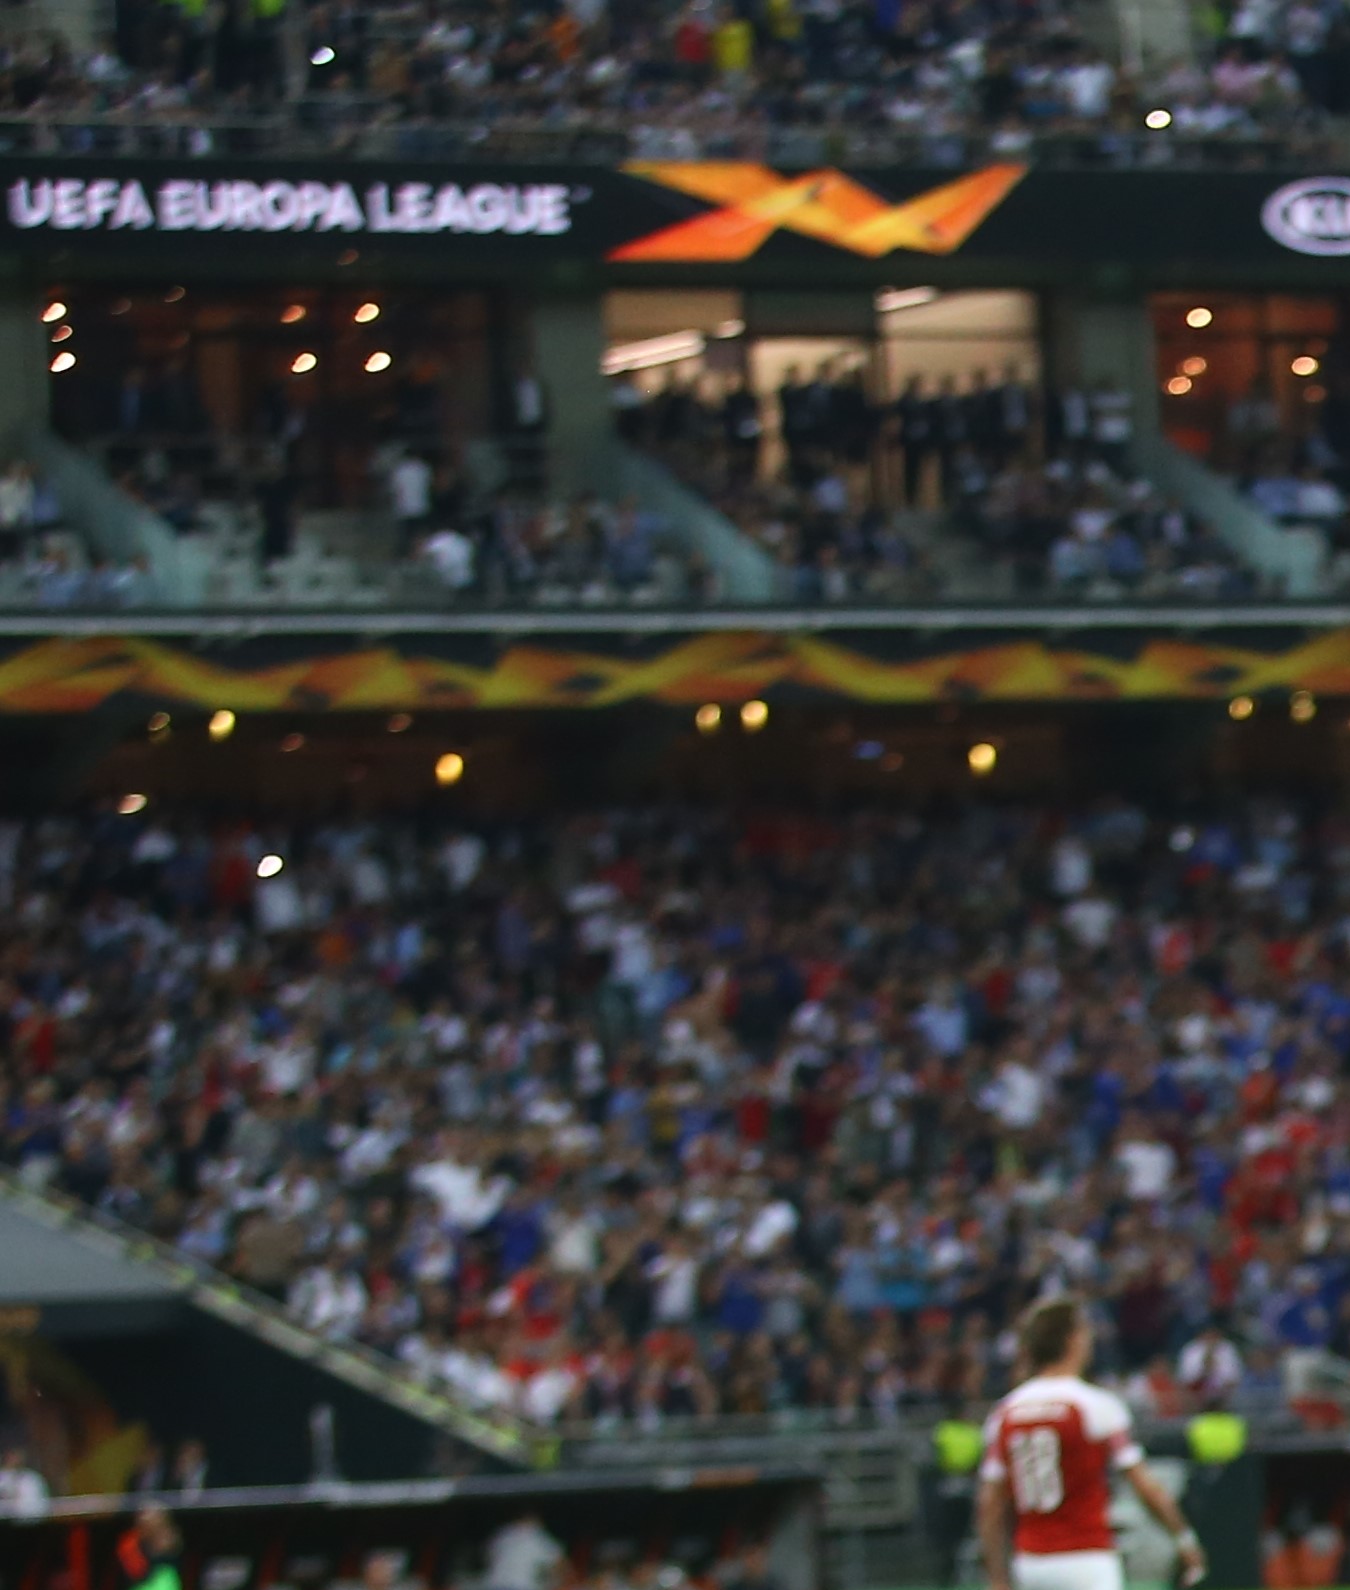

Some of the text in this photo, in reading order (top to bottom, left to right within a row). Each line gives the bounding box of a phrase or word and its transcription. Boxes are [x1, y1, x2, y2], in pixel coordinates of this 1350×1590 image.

[9, 178, 571, 236] UEFA EUROPA LEAGUE
